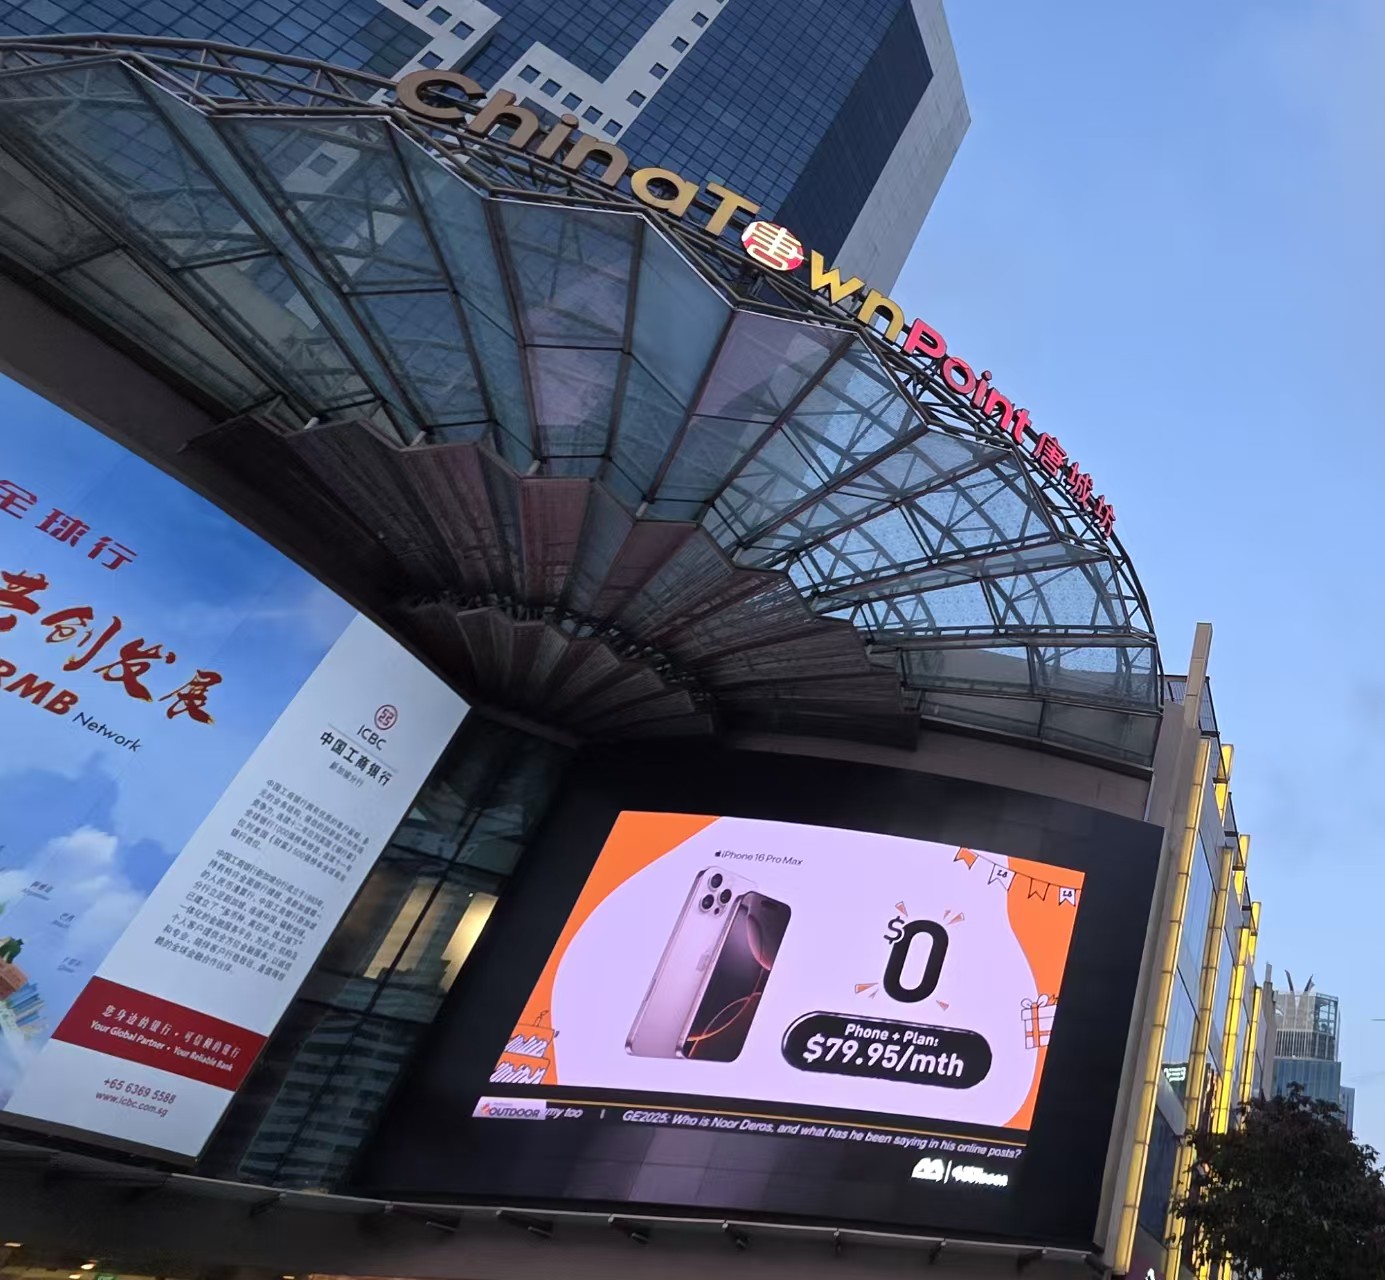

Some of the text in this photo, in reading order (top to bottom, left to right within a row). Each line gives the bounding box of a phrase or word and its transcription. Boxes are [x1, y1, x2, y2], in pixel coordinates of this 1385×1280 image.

[903, 318, 1031, 444] Point
[1034, 432, 1116, 538] 唐城坊
[72, 712, 142, 752] Network
[357, 724, 387, 751] ICBC
[320, 732, 393, 787] 中国工商银行
[721, 850, 803, 865] iPhone 16 Pro Max
[91, 1020, 110, 1033] Your
[110, 1026, 136, 1041] Global
[136, 1036, 165, 1050] Partner
[173, 1045, 190, 1058] Your
[216, 1059, 233, 1073] Bank
[844, 1023, 889, 1041] Phone
[903, 1030, 939, 1047] Plan:
[802, 1033, 964, 1078] $79.95/mth
[96, 1092, 168, 1117] www.icbc.com.sg
[103, 1078, 123, 1090] +65
[125, 1082, 151, 1097] 6369
[488, 1107, 540, 1118] OUTDOOR
[622, 1110, 670, 1124] GE2025:
[672, 1114, 696, 1126] Who
[699, 1116, 710, 1127] is
[777, 1123, 800, 1135] and
[801, 1126, 826, 1137] what
[828, 1127, 848, 1140] has
[849, 1129, 862, 1141] he
[865, 1131, 892, 1144] been
[894, 1136, 928, 1150] saying
[928, 1137, 939, 1148] in
[940, 1140, 955, 1152] his
[957, 1142, 987, 1156] online
[987, 1147, 1022, 1159] posts?
